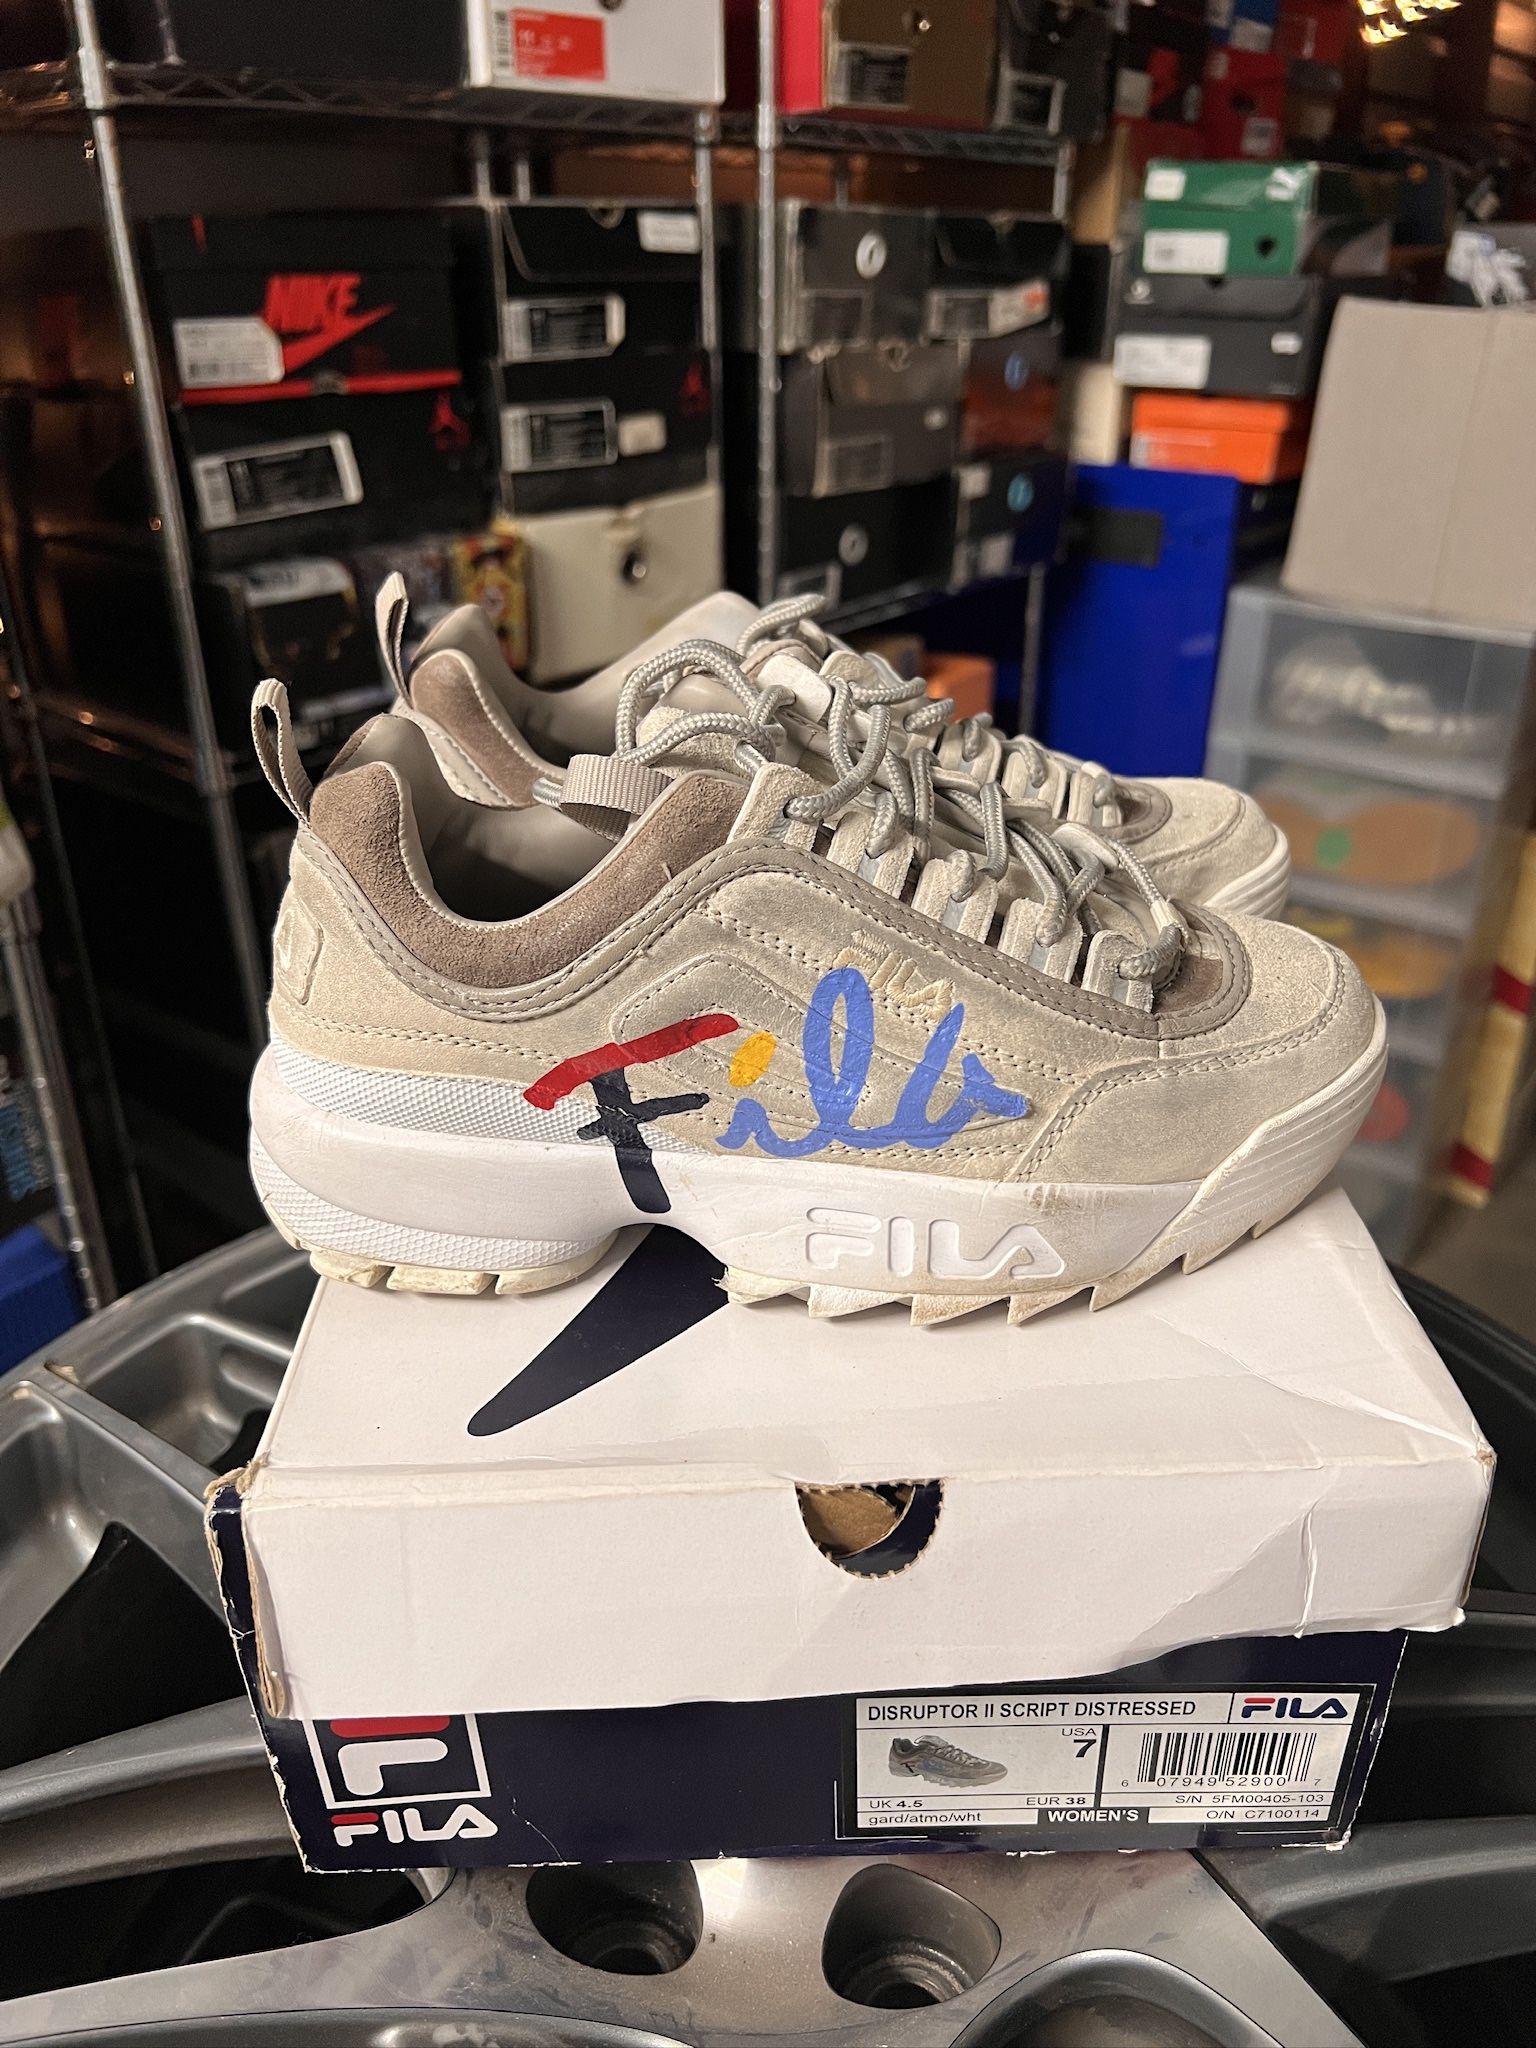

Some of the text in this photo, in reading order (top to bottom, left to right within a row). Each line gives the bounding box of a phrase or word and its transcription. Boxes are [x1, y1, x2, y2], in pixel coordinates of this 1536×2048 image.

[832, 929, 956, 1025] FILA
[805, 1207, 1066, 1280] FILA
[868, 1701, 1196, 1721] DISRUPTOR II SCRIPT DISTRESSED
[1241, 1697, 1348, 1719] FILA
[1061, 1728, 1097, 1737] USA
[1073, 1739, 1097, 1758] 7
[1121, 1777, 1321, 1788] 6 07949 52900 7
[869, 1800, 924, 1809] UK 4.5
[1026, 1797, 1086, 1806] EUR 38
[1175, 1794, 1324, 1804] S/N 5FM00405-103
[868, 1812, 981, 1826] gard/atmo/wht
[1048, 1810, 1139, 1823] WOMEN'S
[1206, 1809, 1319, 1820] O/N C7100114
[331, 1803, 498, 1847] FILA
